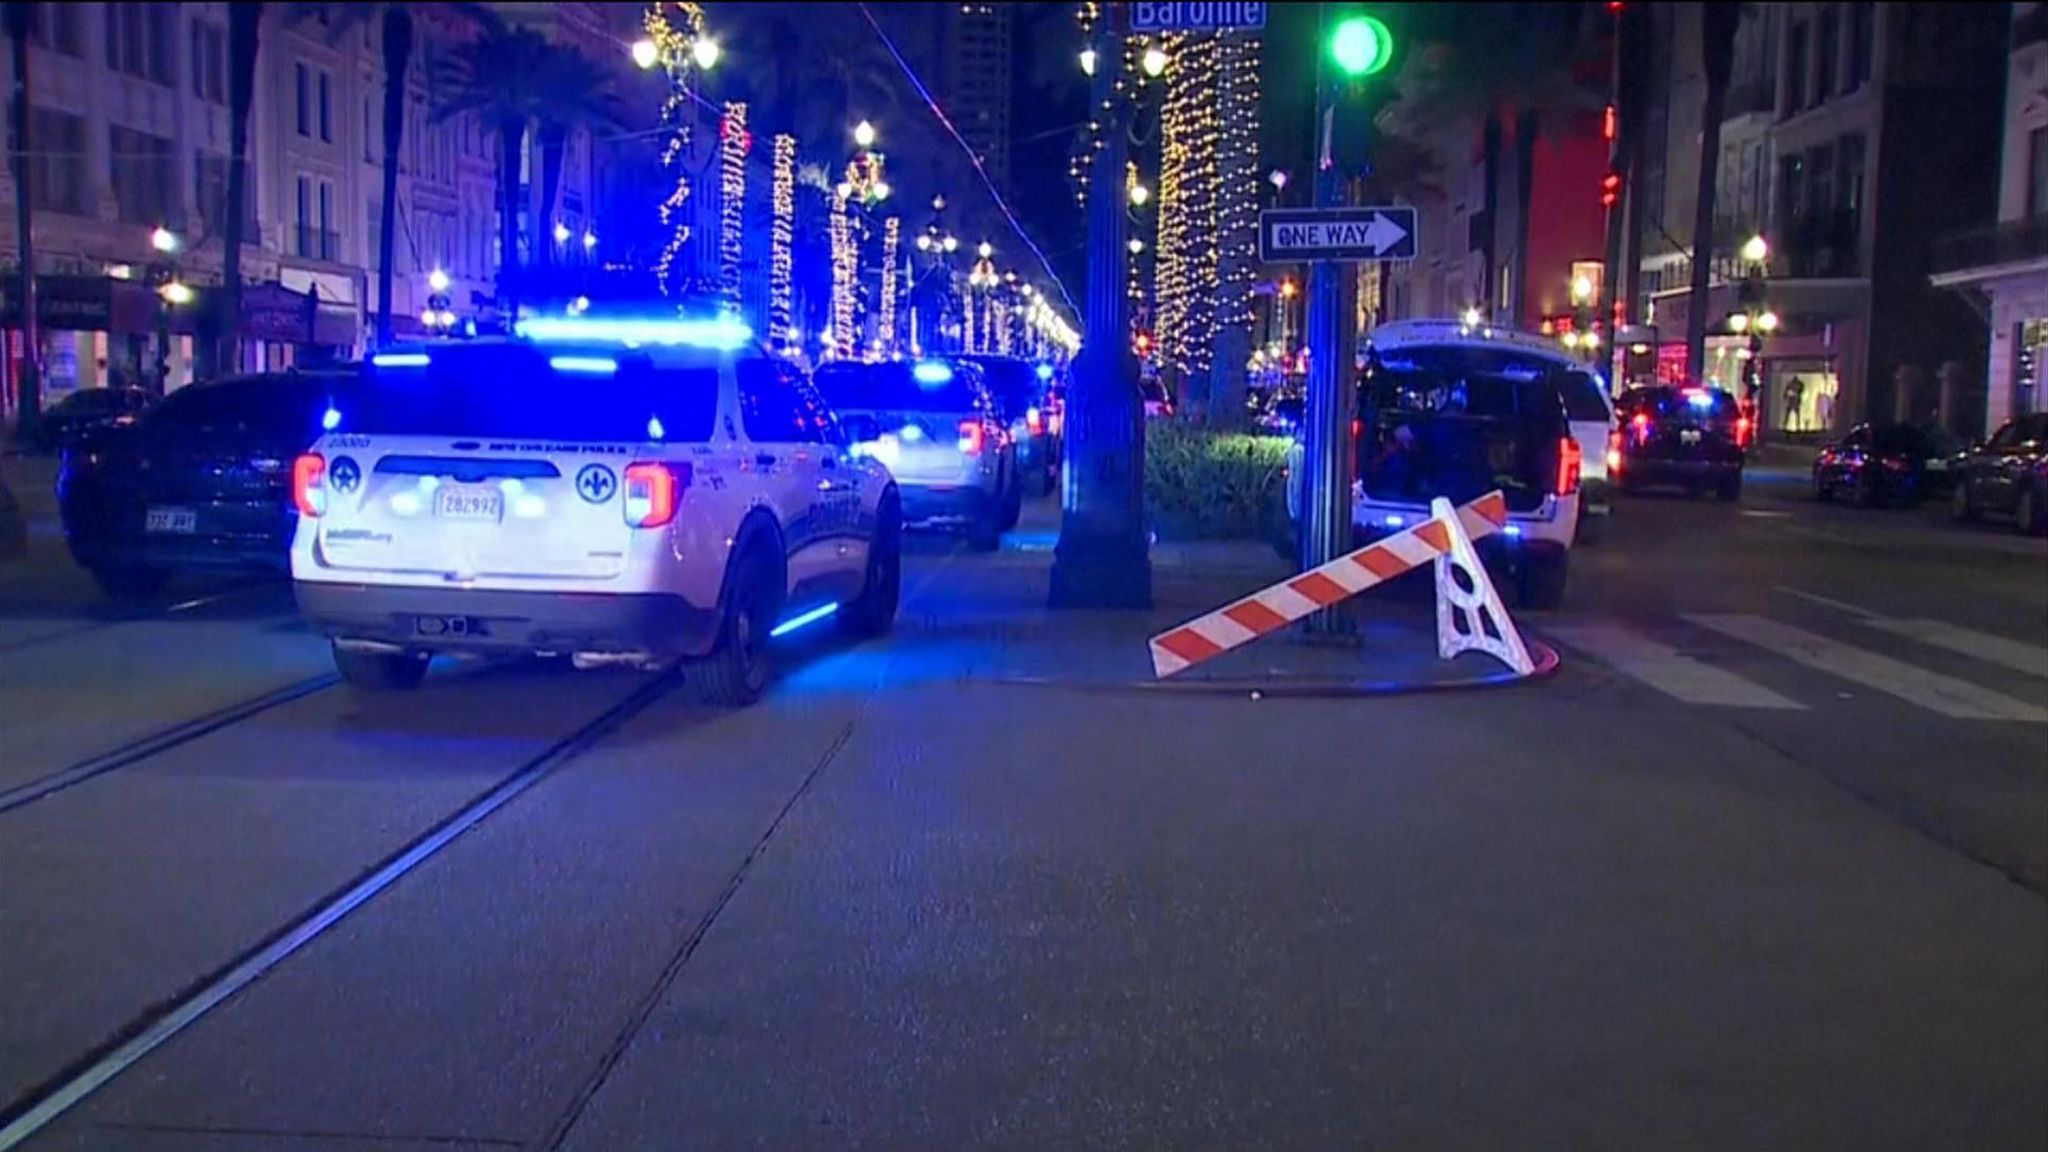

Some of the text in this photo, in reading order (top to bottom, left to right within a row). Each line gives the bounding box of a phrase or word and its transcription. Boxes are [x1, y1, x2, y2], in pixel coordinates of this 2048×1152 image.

[1137, 2, 1259, 23] Baronne
[1278, 225, 1369, 246] ONE WAY
